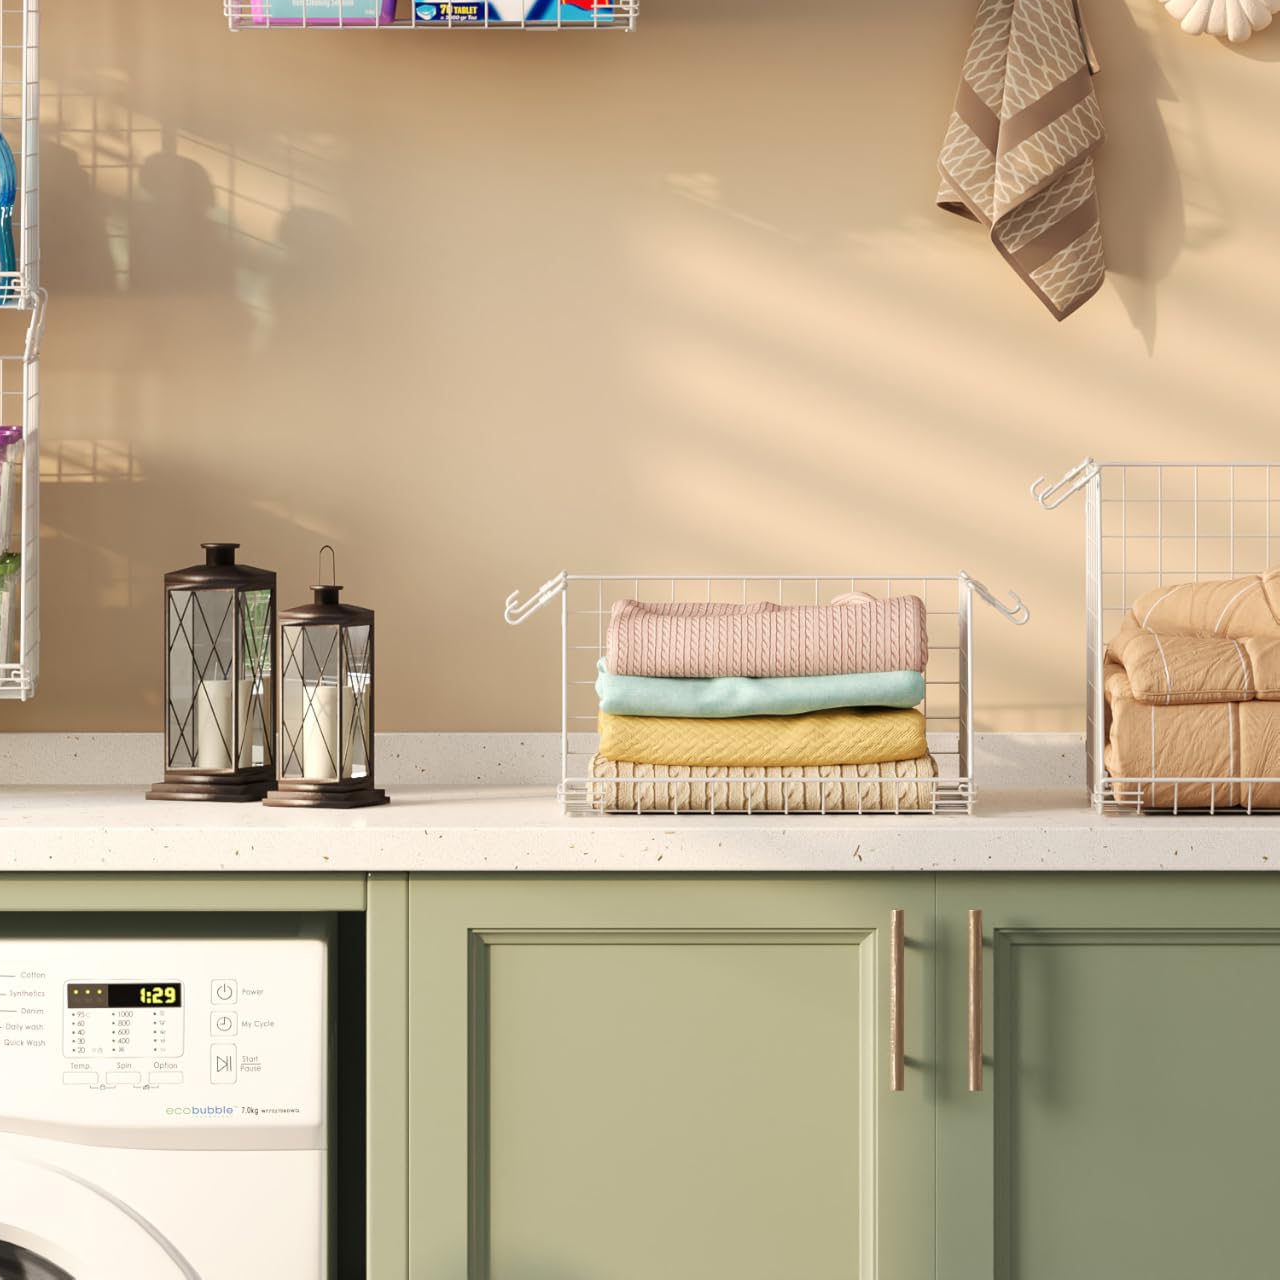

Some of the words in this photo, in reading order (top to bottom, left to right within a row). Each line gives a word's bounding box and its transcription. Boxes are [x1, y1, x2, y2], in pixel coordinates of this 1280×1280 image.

[453, 6, 477, 14] TABLET
[9, 990, 45, 998] Synthetics
[140, 987, 177, 1004] 1:29
[242, 988, 264, 996] Power
[5, 1023, 23, 1031] Daily
[241, 1020, 251, 1028] My
[253, 1020, 274, 1028] Cycle
[4, 1039, 24, 1047] Quick
[242, 1055, 258, 1063] Start
[117, 1062, 132, 1070] Spin
[153, 1062, 178, 1070] Option
[240, 1064, 262, 1072] Pause
[241, 1107, 258, 1115] 7.0kg
